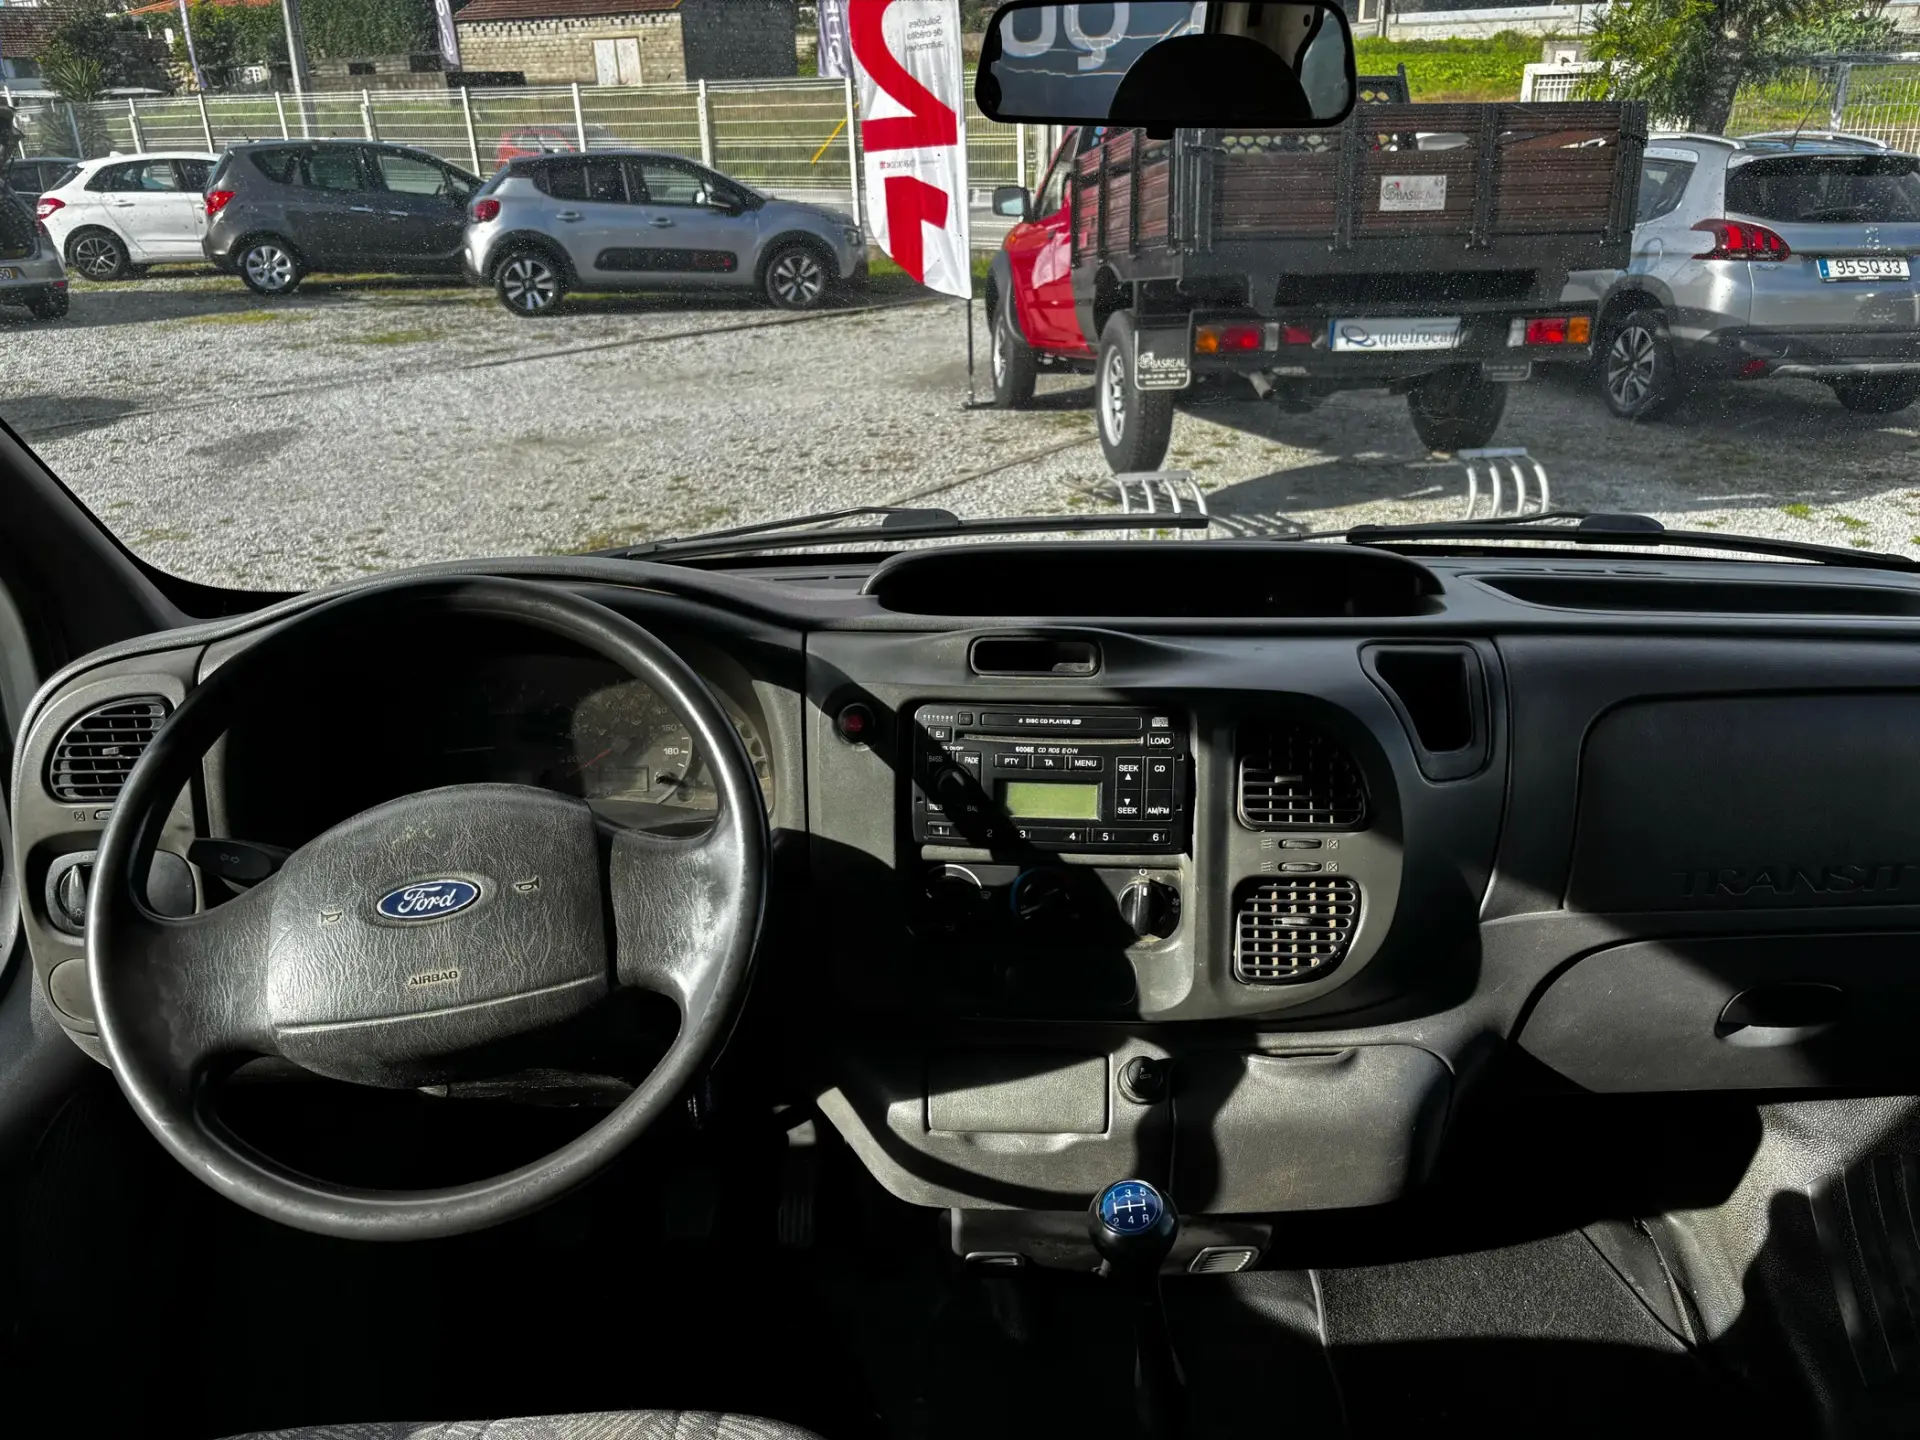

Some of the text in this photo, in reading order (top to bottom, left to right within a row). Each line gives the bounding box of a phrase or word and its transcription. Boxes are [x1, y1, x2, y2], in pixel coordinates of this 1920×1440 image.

[1884, 259, 1902, 274] 33
[935, 730, 945, 738] EJ
[1150, 737, 1171, 745] LOAD
[964, 756, 979, 764] FADE
[1004, 757, 1020, 765] PTY
[1074, 759, 1097, 767] MENU
[1118, 764, 1139, 772] SEEK
[1154, 764, 1165, 772] CD
[1146, 807, 1170, 815] AM/FM
[986, 829, 993, 838] 2
[1019, 830, 1026, 838] 3
[1069, 832, 1076, 841] 4
[1102, 832, 1109, 841] 5
[1152, 833, 1159, 841] 6
[1671, 862, 1918, 898] TRANSIT
[397, 886, 456, 913] Ford
[409, 970, 458, 986] AIRBAG
[1125, 1189, 1132, 1197] 3
[1140, 1188, 1147, 1196] 5
[1113, 1214, 1149, 1227] 2 4 R
